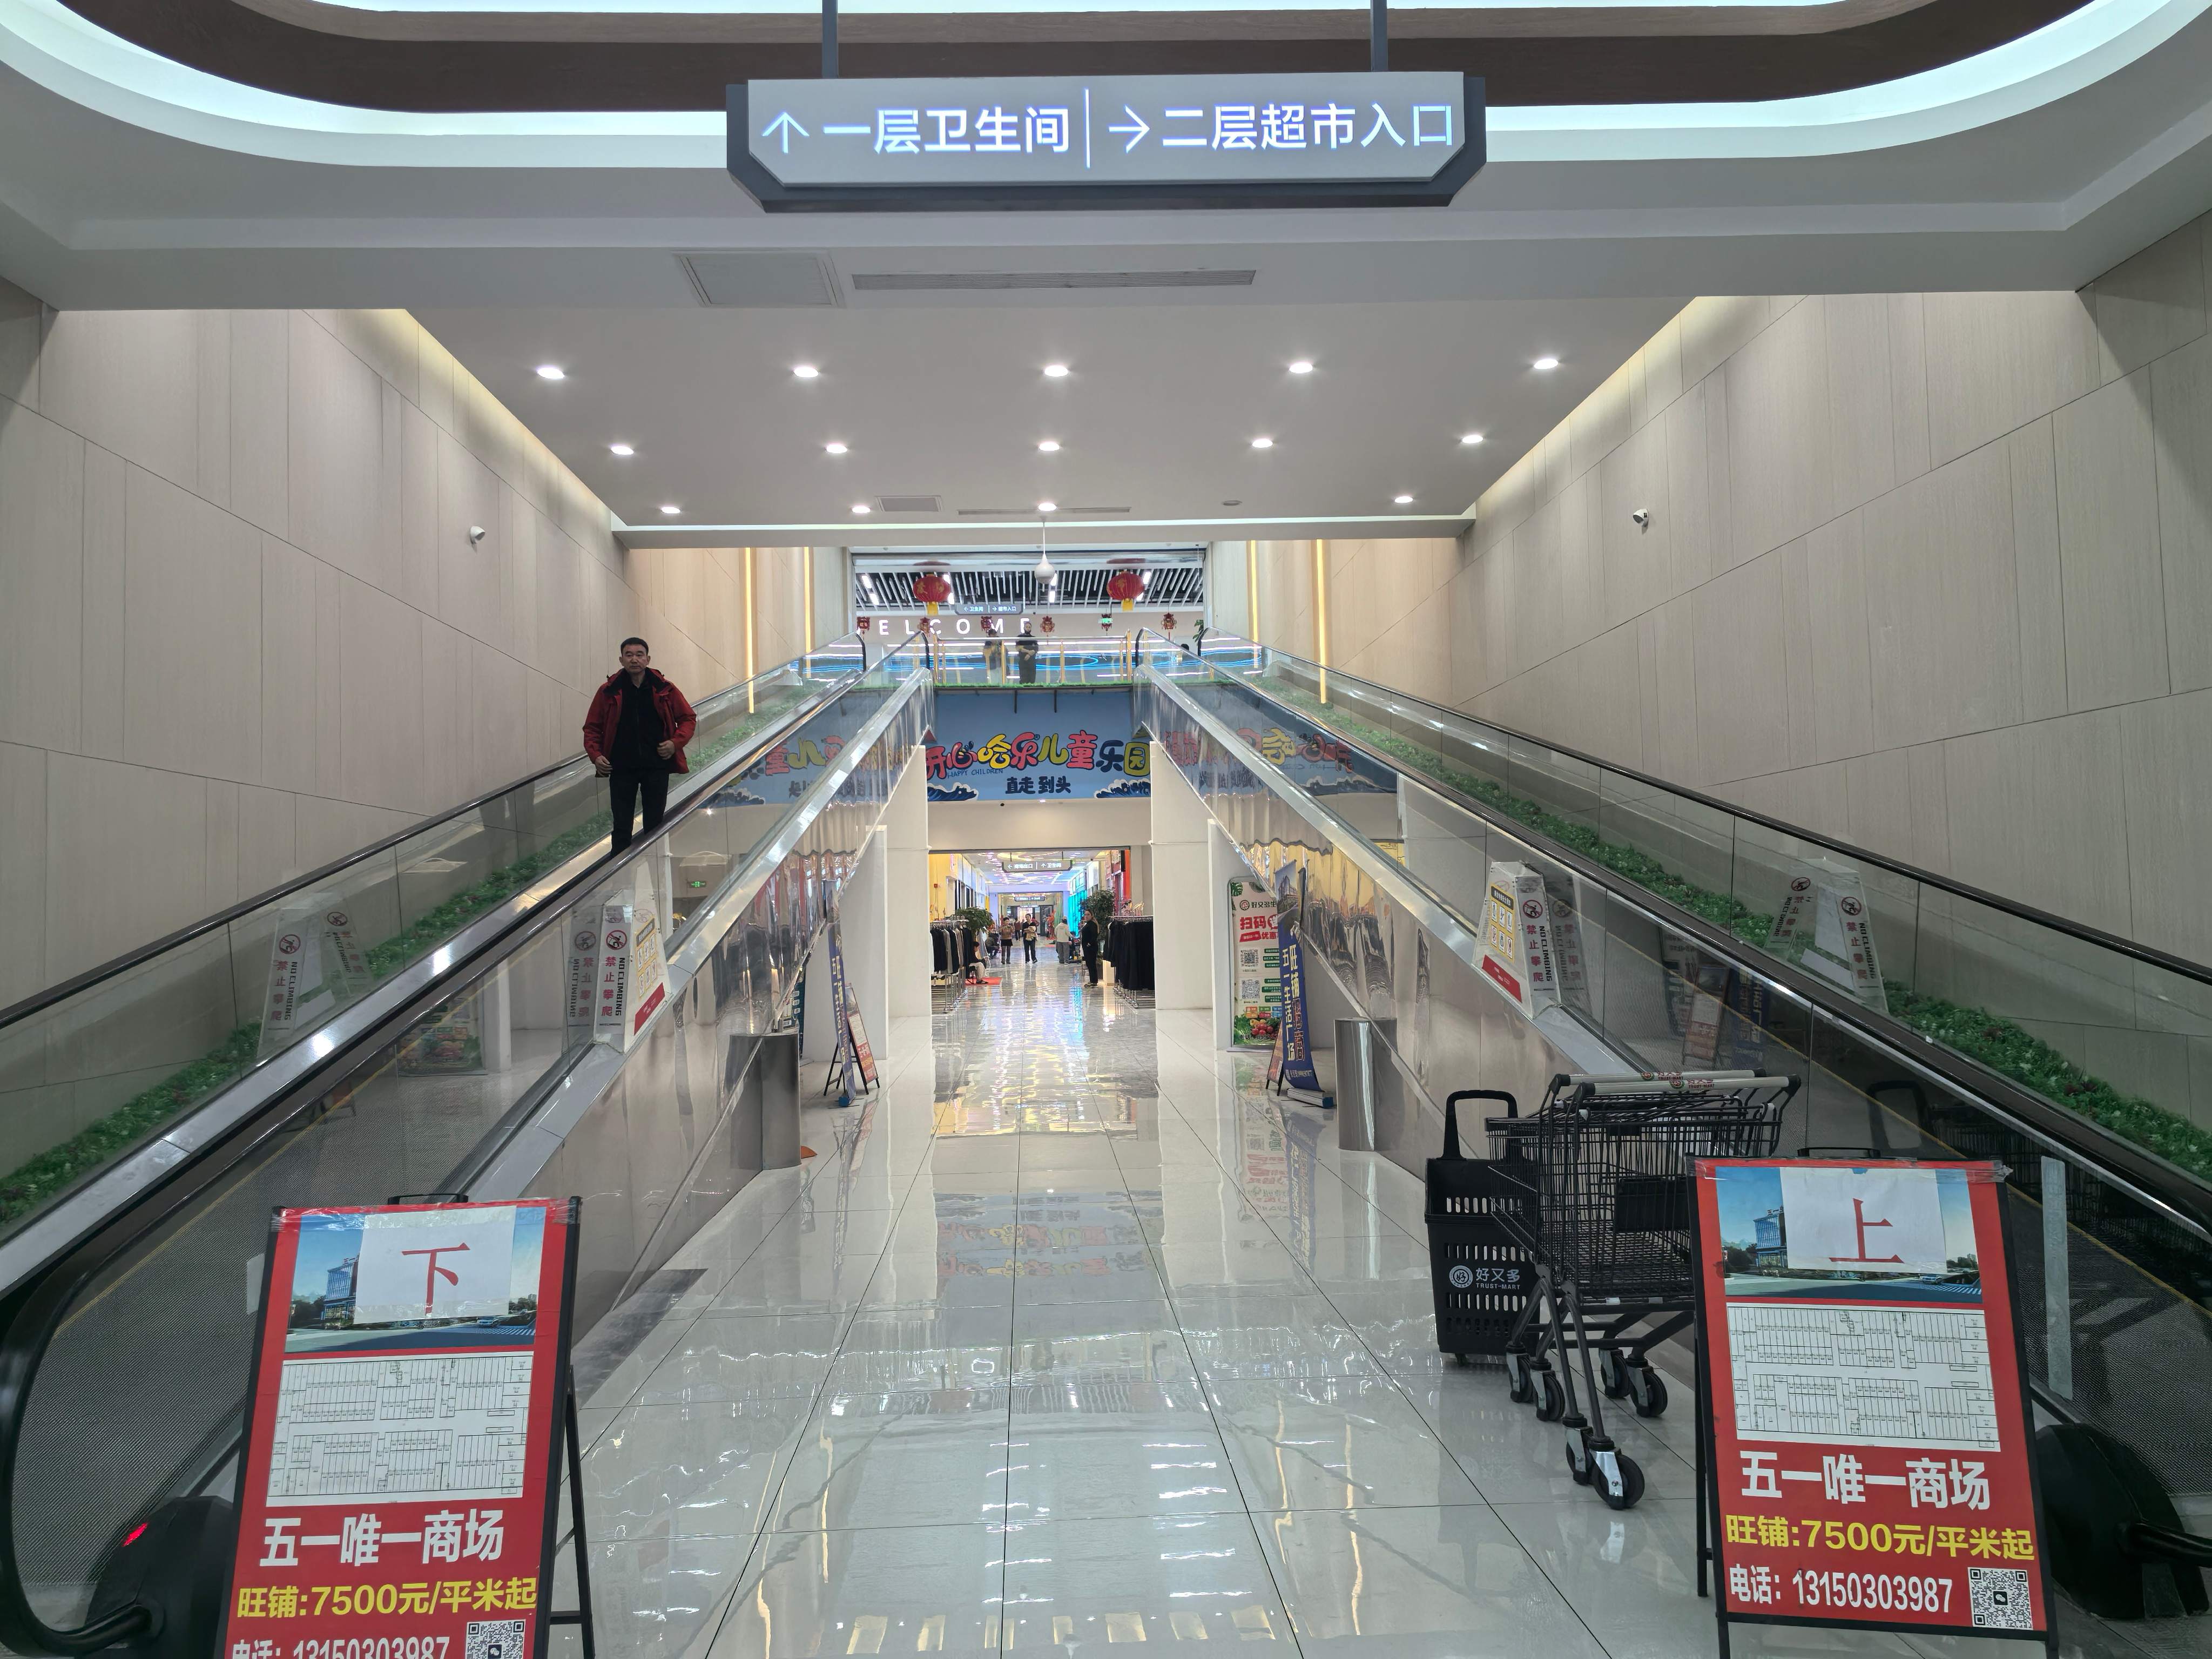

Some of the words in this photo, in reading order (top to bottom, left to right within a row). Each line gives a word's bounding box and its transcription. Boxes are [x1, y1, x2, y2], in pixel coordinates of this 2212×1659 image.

[824, 106, 1069, 153] 一层卫生间
[1162, 102, 1454, 150] 二层超市入口
[947, 770, 968, 778] HAPPY
[1006, 776, 1071, 794] 直走到头
[1539, 926, 1546, 937] NO
[619, 957, 625, 970] NO
[1541, 939, 1552, 981] CLIMBING
[602, 956, 617, 1016] 禁止攀爬
[616, 972, 625, 1016] CLIMBING
[1829, 1197, 1905, 1264] 上
[401, 1242, 471, 1314] 下
[1475, 1267, 1520, 1283] 好又多
[1739, 1449, 1991, 1511] 五一唯一商场
[259, 1508, 504, 1567] 五一唯一商场
[1726, 1514, 2035, 1561] 旺铺:7500元/平米起
[236, 1577, 537, 1618] 旺铺:7500元/平米起
